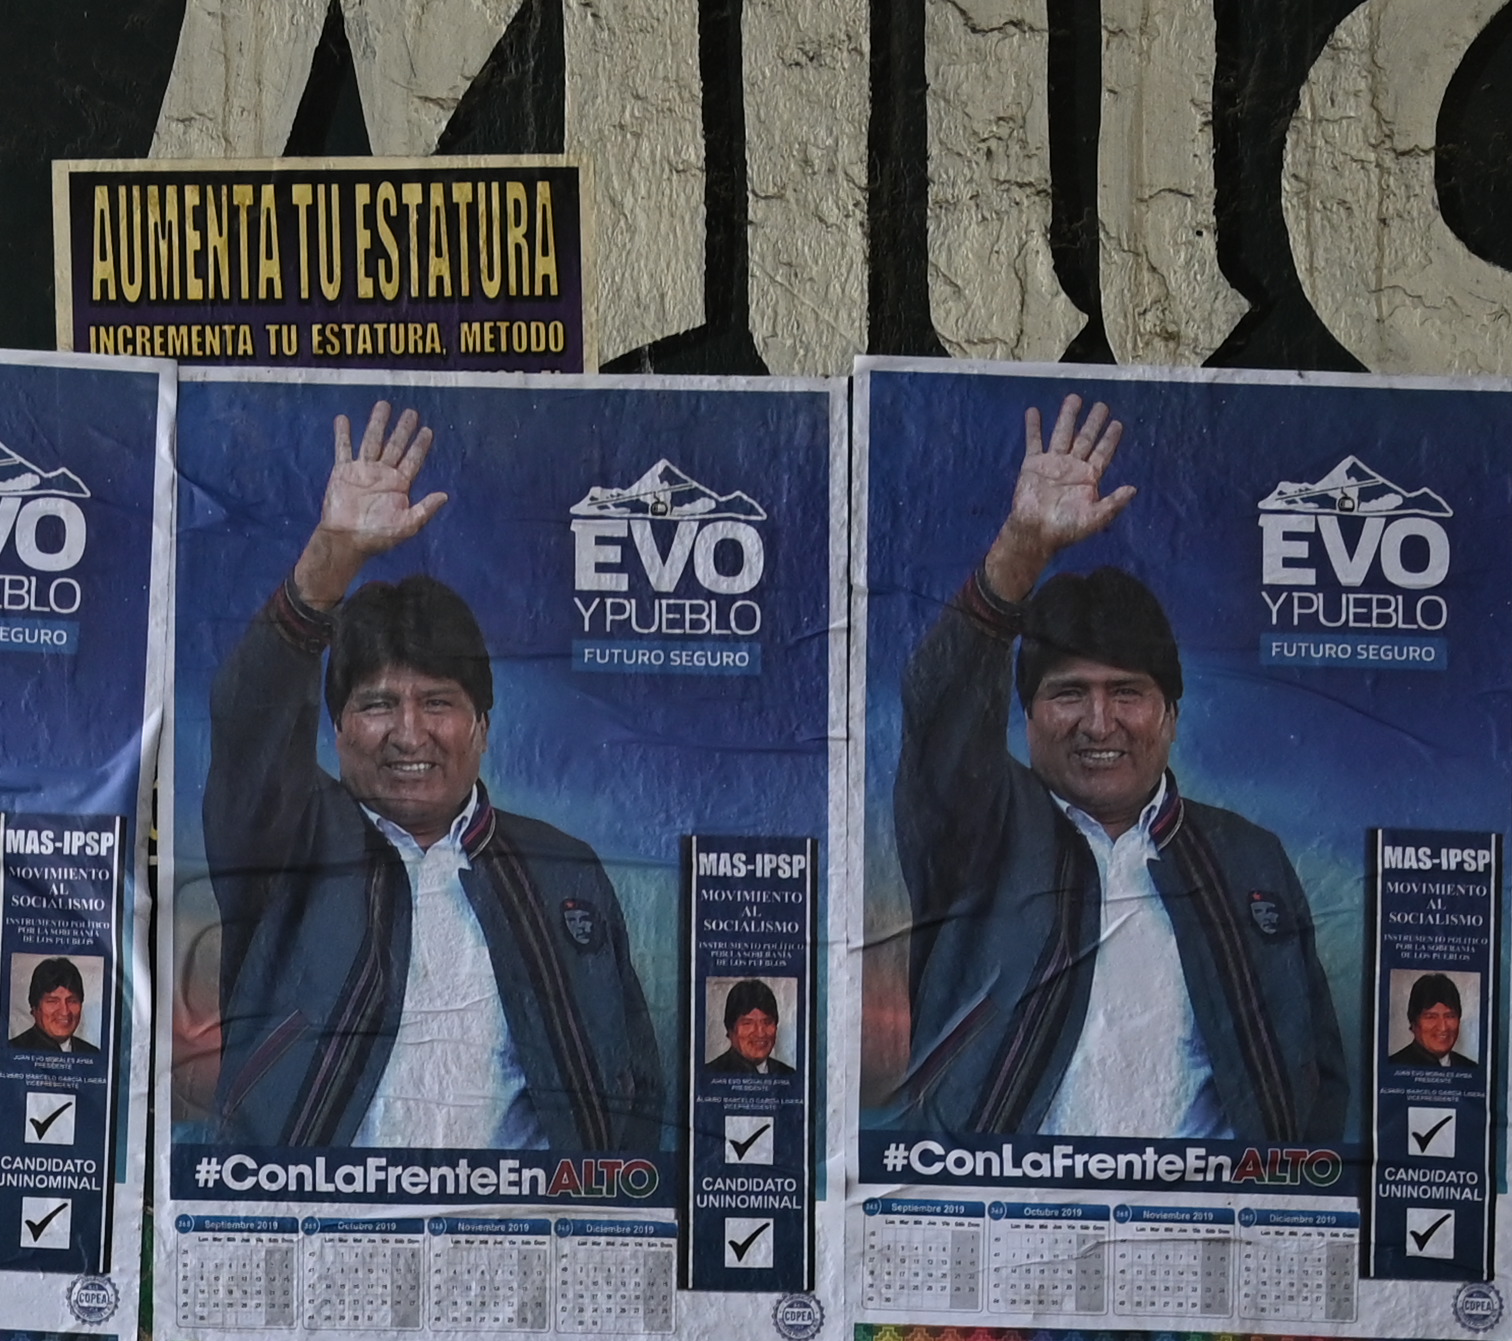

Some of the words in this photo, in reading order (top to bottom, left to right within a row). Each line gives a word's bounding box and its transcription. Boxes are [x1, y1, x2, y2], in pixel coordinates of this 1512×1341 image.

[92, 183, 282, 302] AUMENTA
[292, 183, 340, 301] TU
[356, 181, 559, 300] ESTATURA
[89, 324, 254, 356] INCREMENTA
[265, 324, 298, 355] TU
[311, 322, 447, 356] ESTATURA,
[460, 321, 565, 353] METODO
[570, 519, 763, 594] EVO
[1259, 513, 1449, 590] EVO
[698, 853, 806, 878] MAS-IPSP
[195, 1154, 659, 1199] #ConLaFrenteEnALTO
[884, 1139, 1343, 1189] #ConLaFrenteEnALTO
